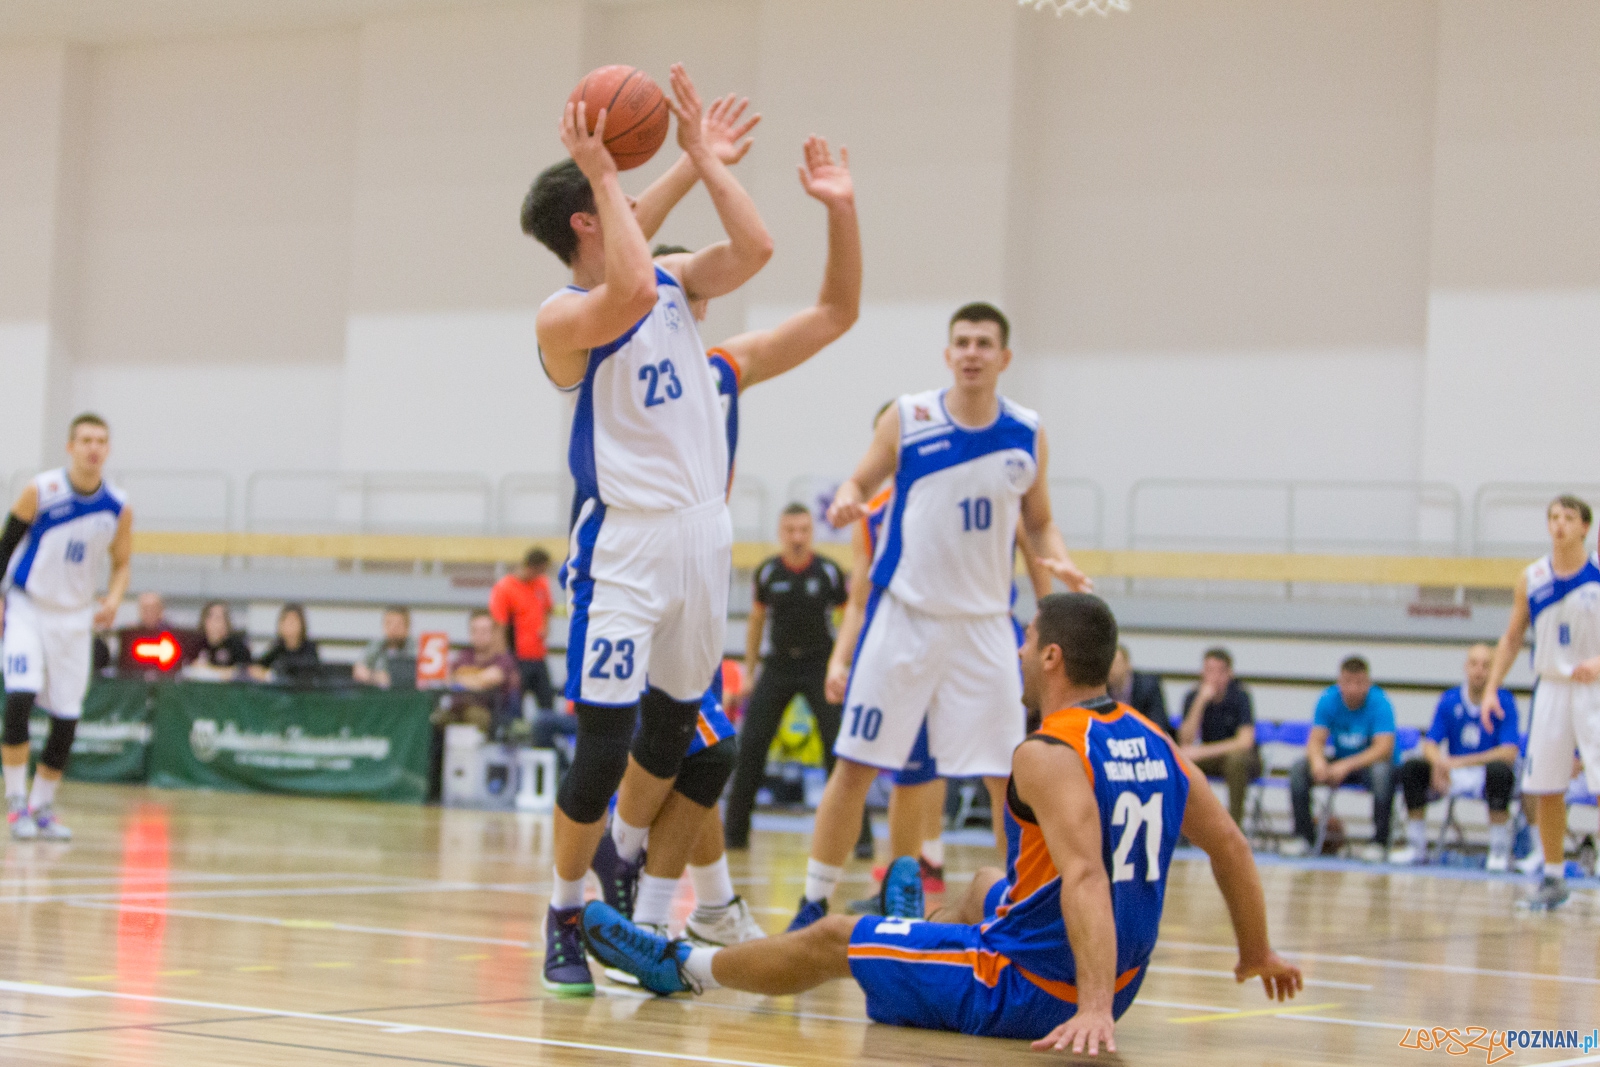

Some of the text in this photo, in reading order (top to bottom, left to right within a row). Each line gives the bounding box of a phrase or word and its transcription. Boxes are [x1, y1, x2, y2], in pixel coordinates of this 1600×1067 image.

[638, 358, 682, 407] 23
[958, 497, 992, 531] 10
[419, 638, 444, 674] 5
[589, 637, 635, 680] 23
[850, 704, 883, 742] 10
[1111, 790, 1164, 883] 21
